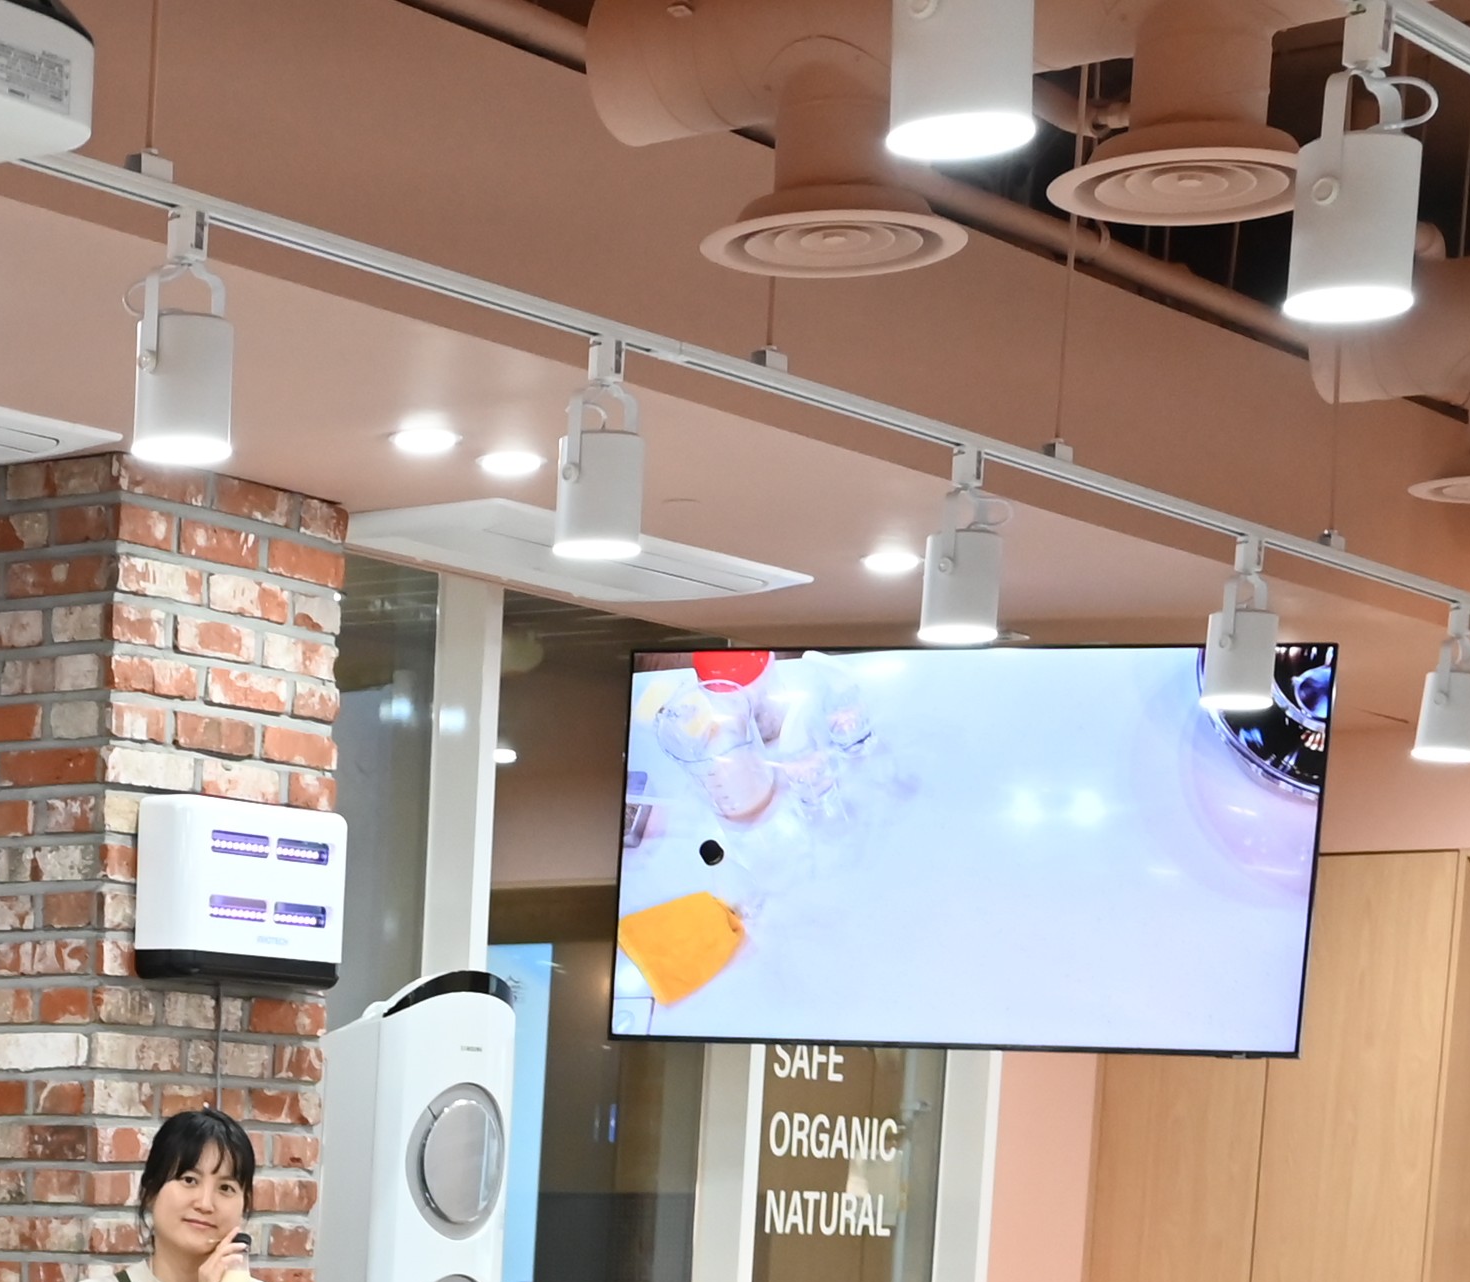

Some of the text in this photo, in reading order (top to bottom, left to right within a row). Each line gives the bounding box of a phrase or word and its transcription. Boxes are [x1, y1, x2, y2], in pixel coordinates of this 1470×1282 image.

[773, 1044, 844, 1083] SAFE
[768, 1110, 899, 1162] ORGANIC
[763, 1188, 892, 1238] NATURAL
